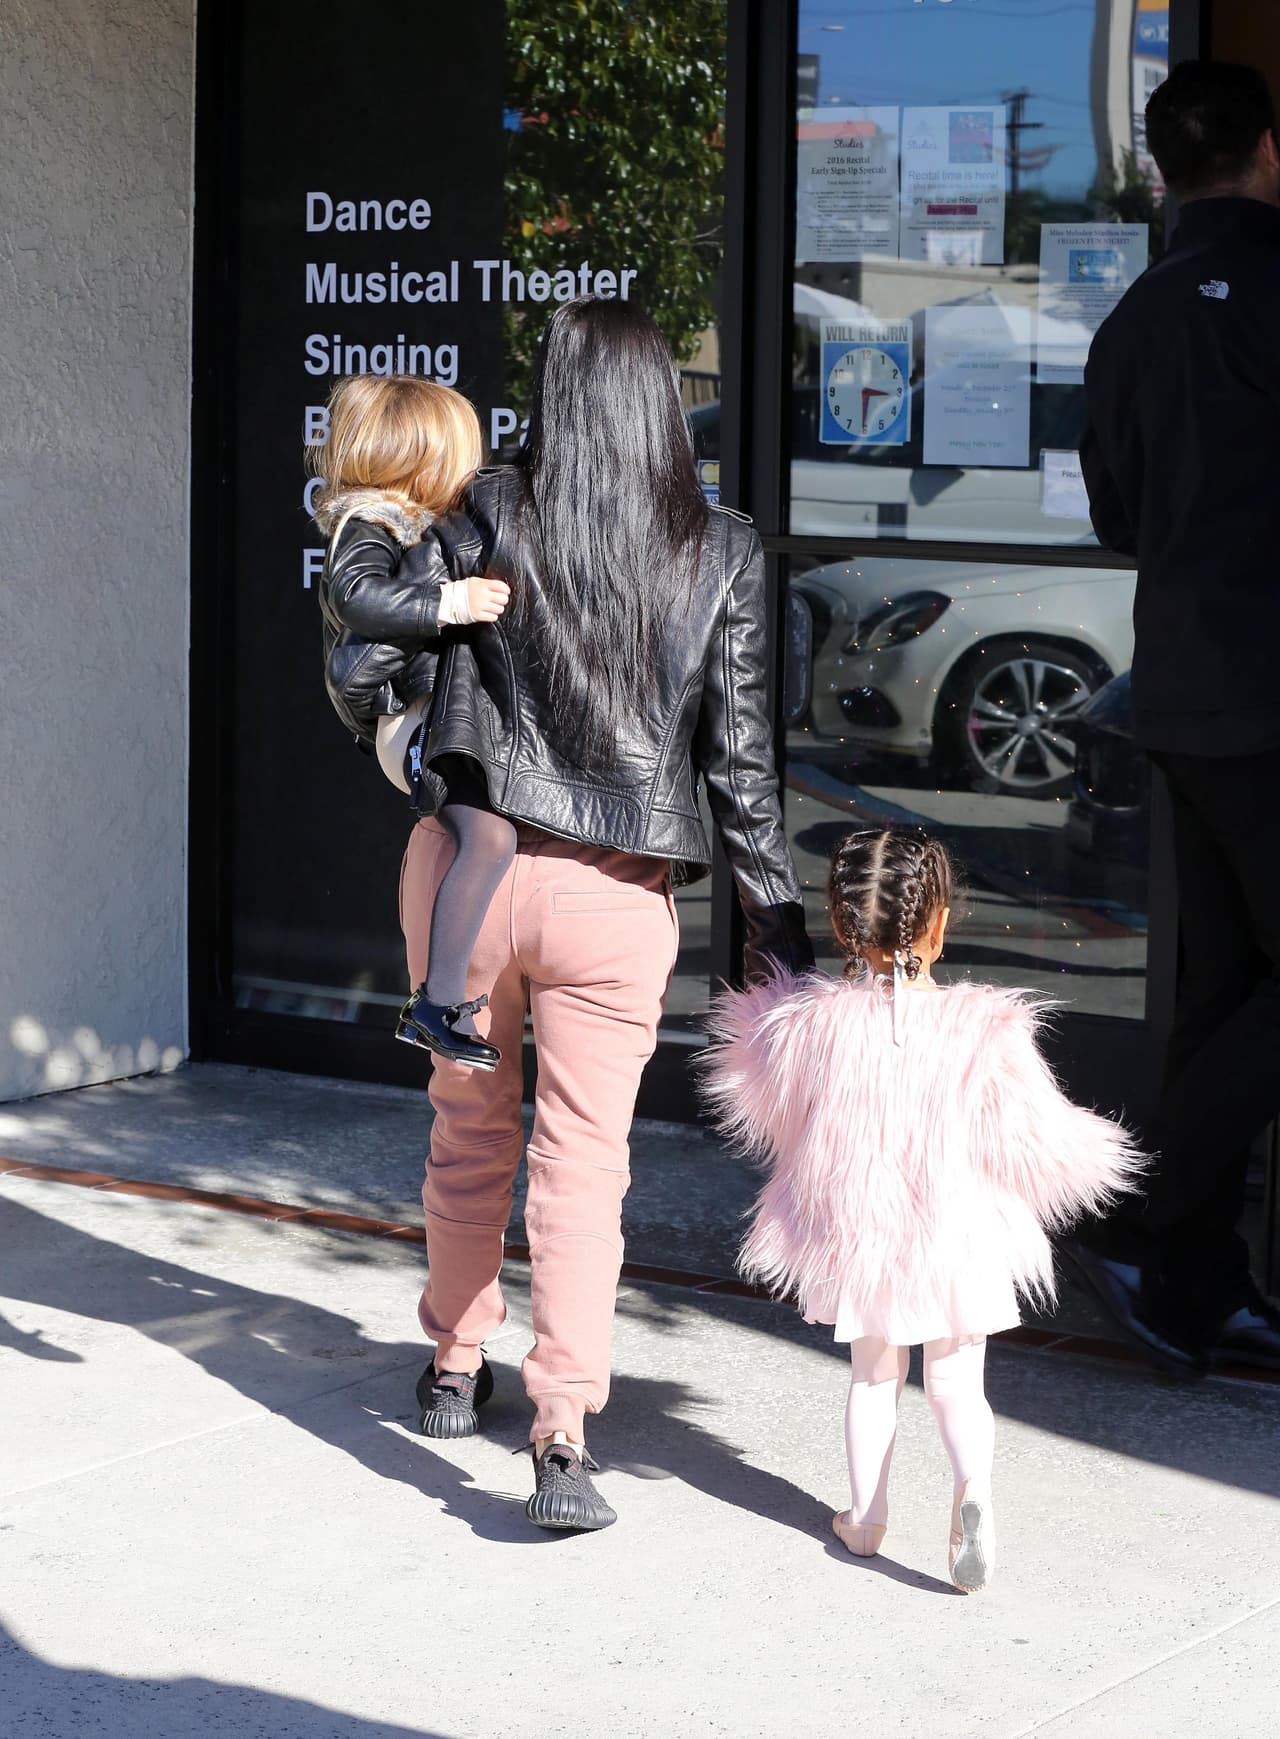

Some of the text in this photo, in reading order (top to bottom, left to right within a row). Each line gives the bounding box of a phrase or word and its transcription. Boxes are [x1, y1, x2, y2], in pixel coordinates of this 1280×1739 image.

[826, 155, 871, 164] 2016 Recital
[811, 167, 829, 177] Early
[858, 165, 888, 176] Specials
[306, 191, 432, 232] Dance
[305, 260, 638, 303] Musical Theater
[825, 326, 908, 341] WILL RETURN
[304, 334, 459, 386] Singing
[846, 354, 854, 365] 11
[861, 349, 872, 361] 12
[892, 369, 899, 380] 2
[829, 386, 836, 397] 9
[896, 387, 903, 398] 3
[834, 405, 841, 416] 8
[890, 405, 897, 417] 4
[846, 419, 853, 430] 7
[878, 419, 885, 430] 5
